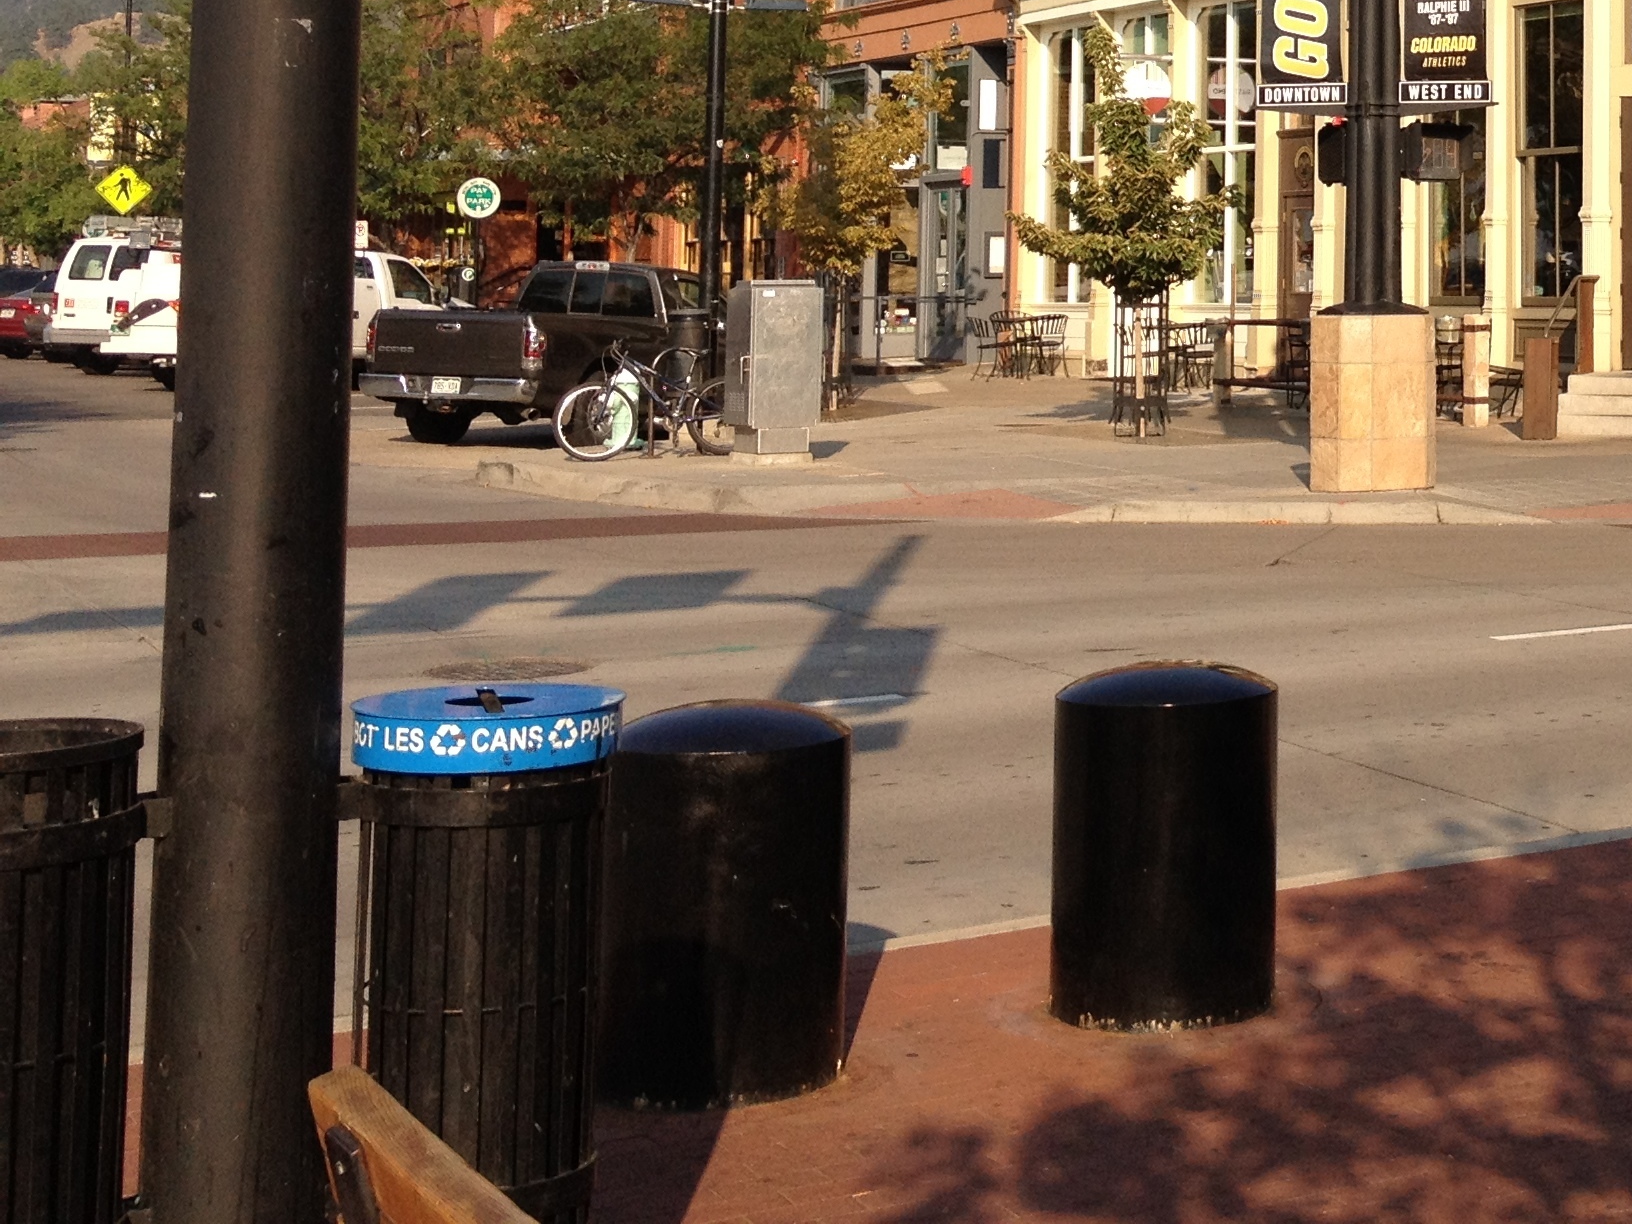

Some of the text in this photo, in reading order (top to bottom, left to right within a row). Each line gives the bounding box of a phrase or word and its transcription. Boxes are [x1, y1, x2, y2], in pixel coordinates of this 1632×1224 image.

[1417, 0, 1457, 14] RALPHIE
[1410, 35, 1476, 54] COLORADO
[1422, 56, 1467, 68] ATHLETICS
[1264, 85, 1341, 102] DOWNTOWN
[1408, 84, 1482, 100] WEST END
[466, 197, 491, 205] PARK
[471, 725, 543, 752] CANS
